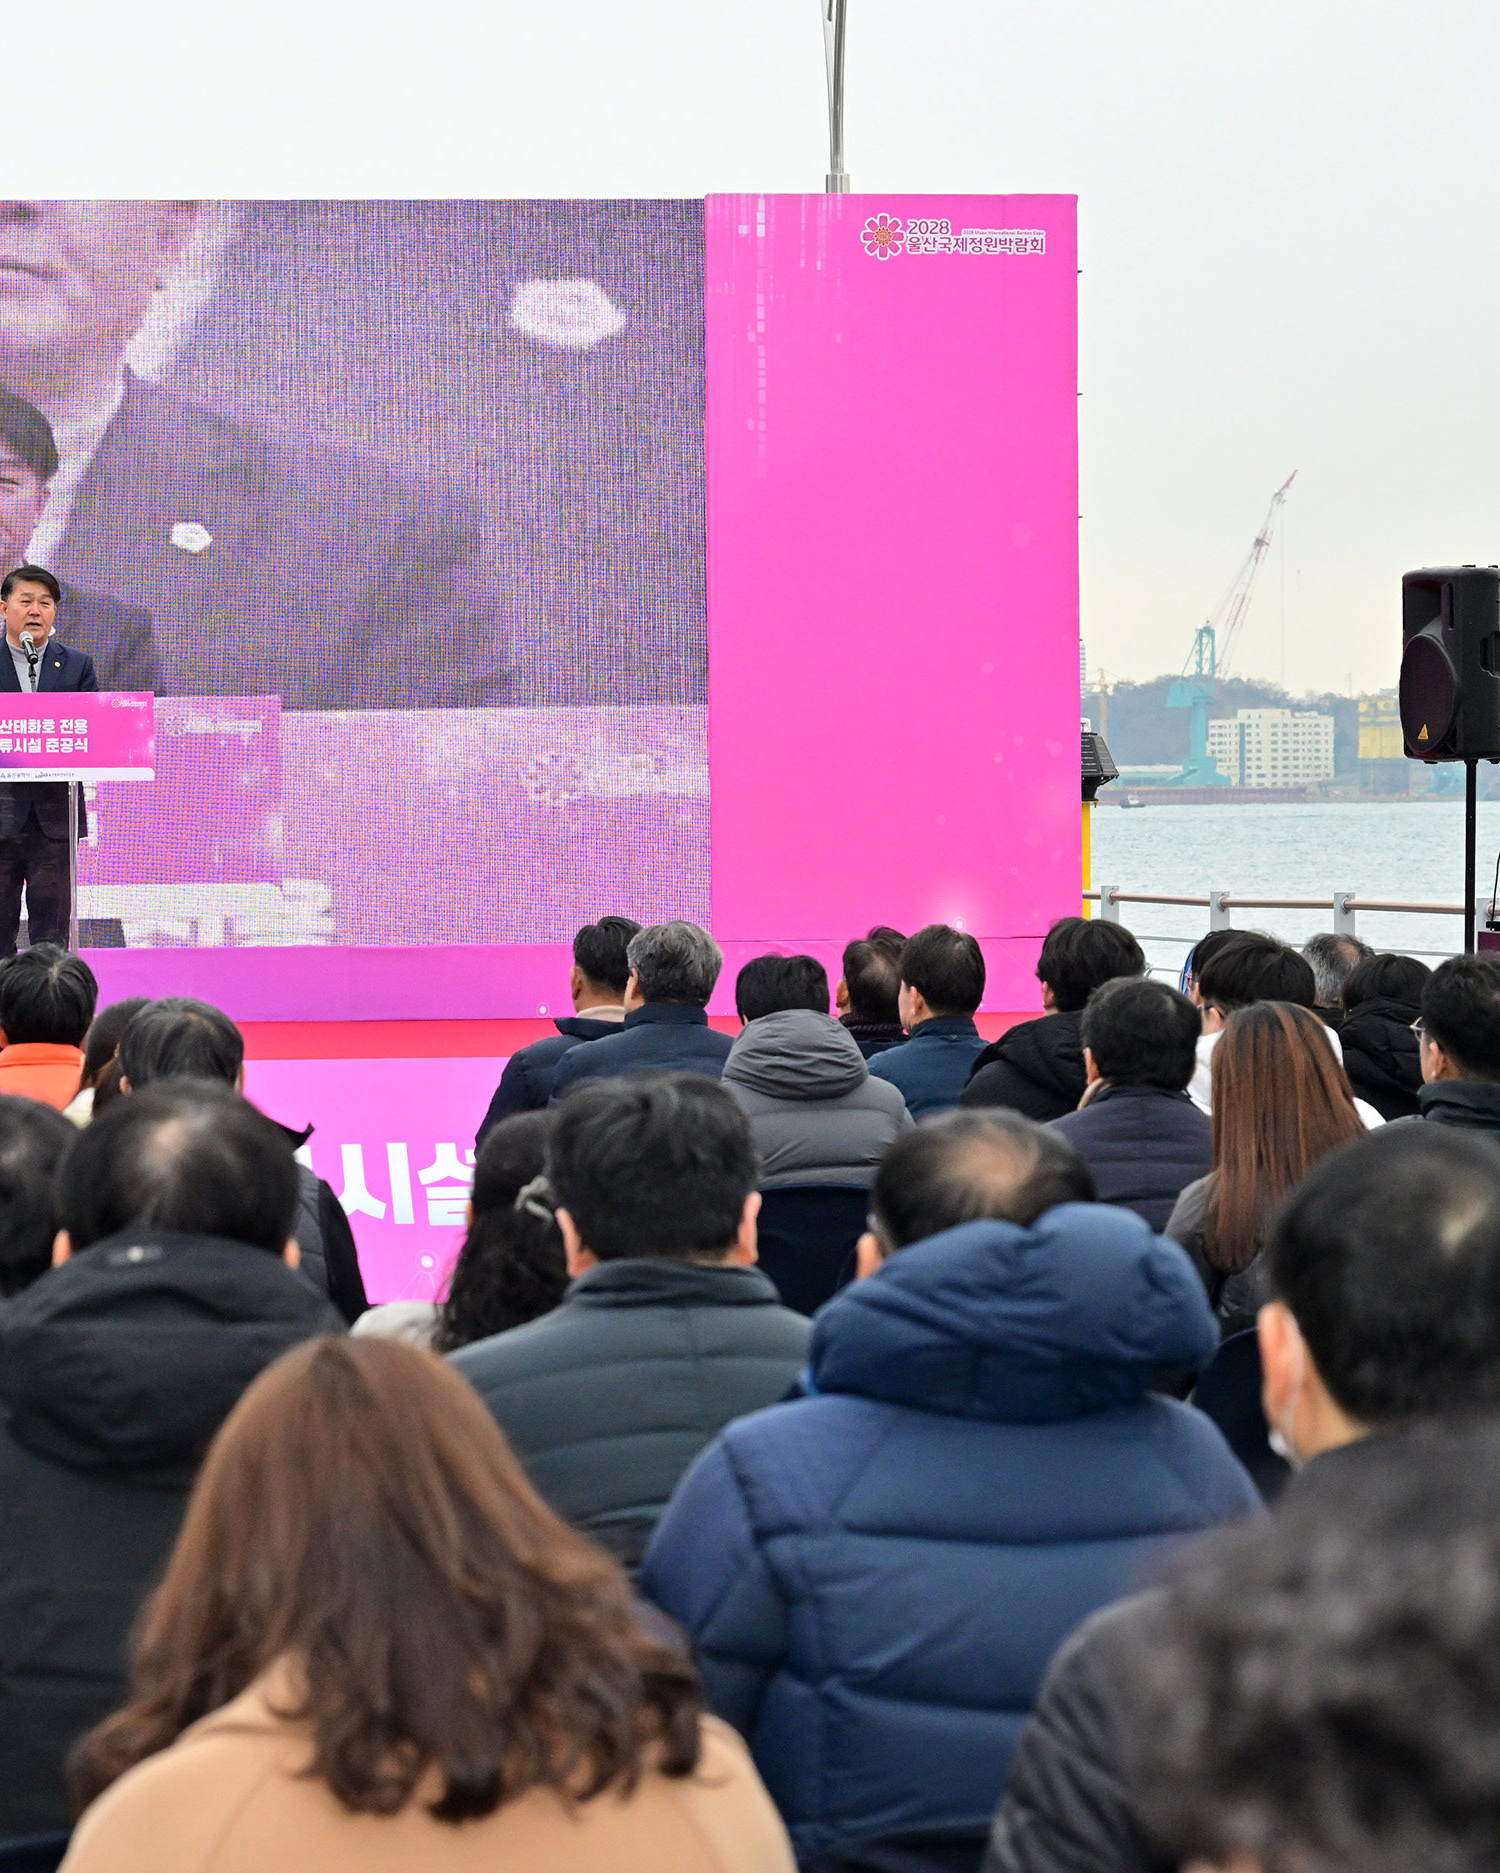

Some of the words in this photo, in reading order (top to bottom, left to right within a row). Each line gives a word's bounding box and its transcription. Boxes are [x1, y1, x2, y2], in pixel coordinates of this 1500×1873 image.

[907, 221, 950, 235] 2028
[907, 236, 1045, 253] 울산국제정원박람회
[59, 718, 88, 735] 전용
[45, 737, 88, 753] 준공식
